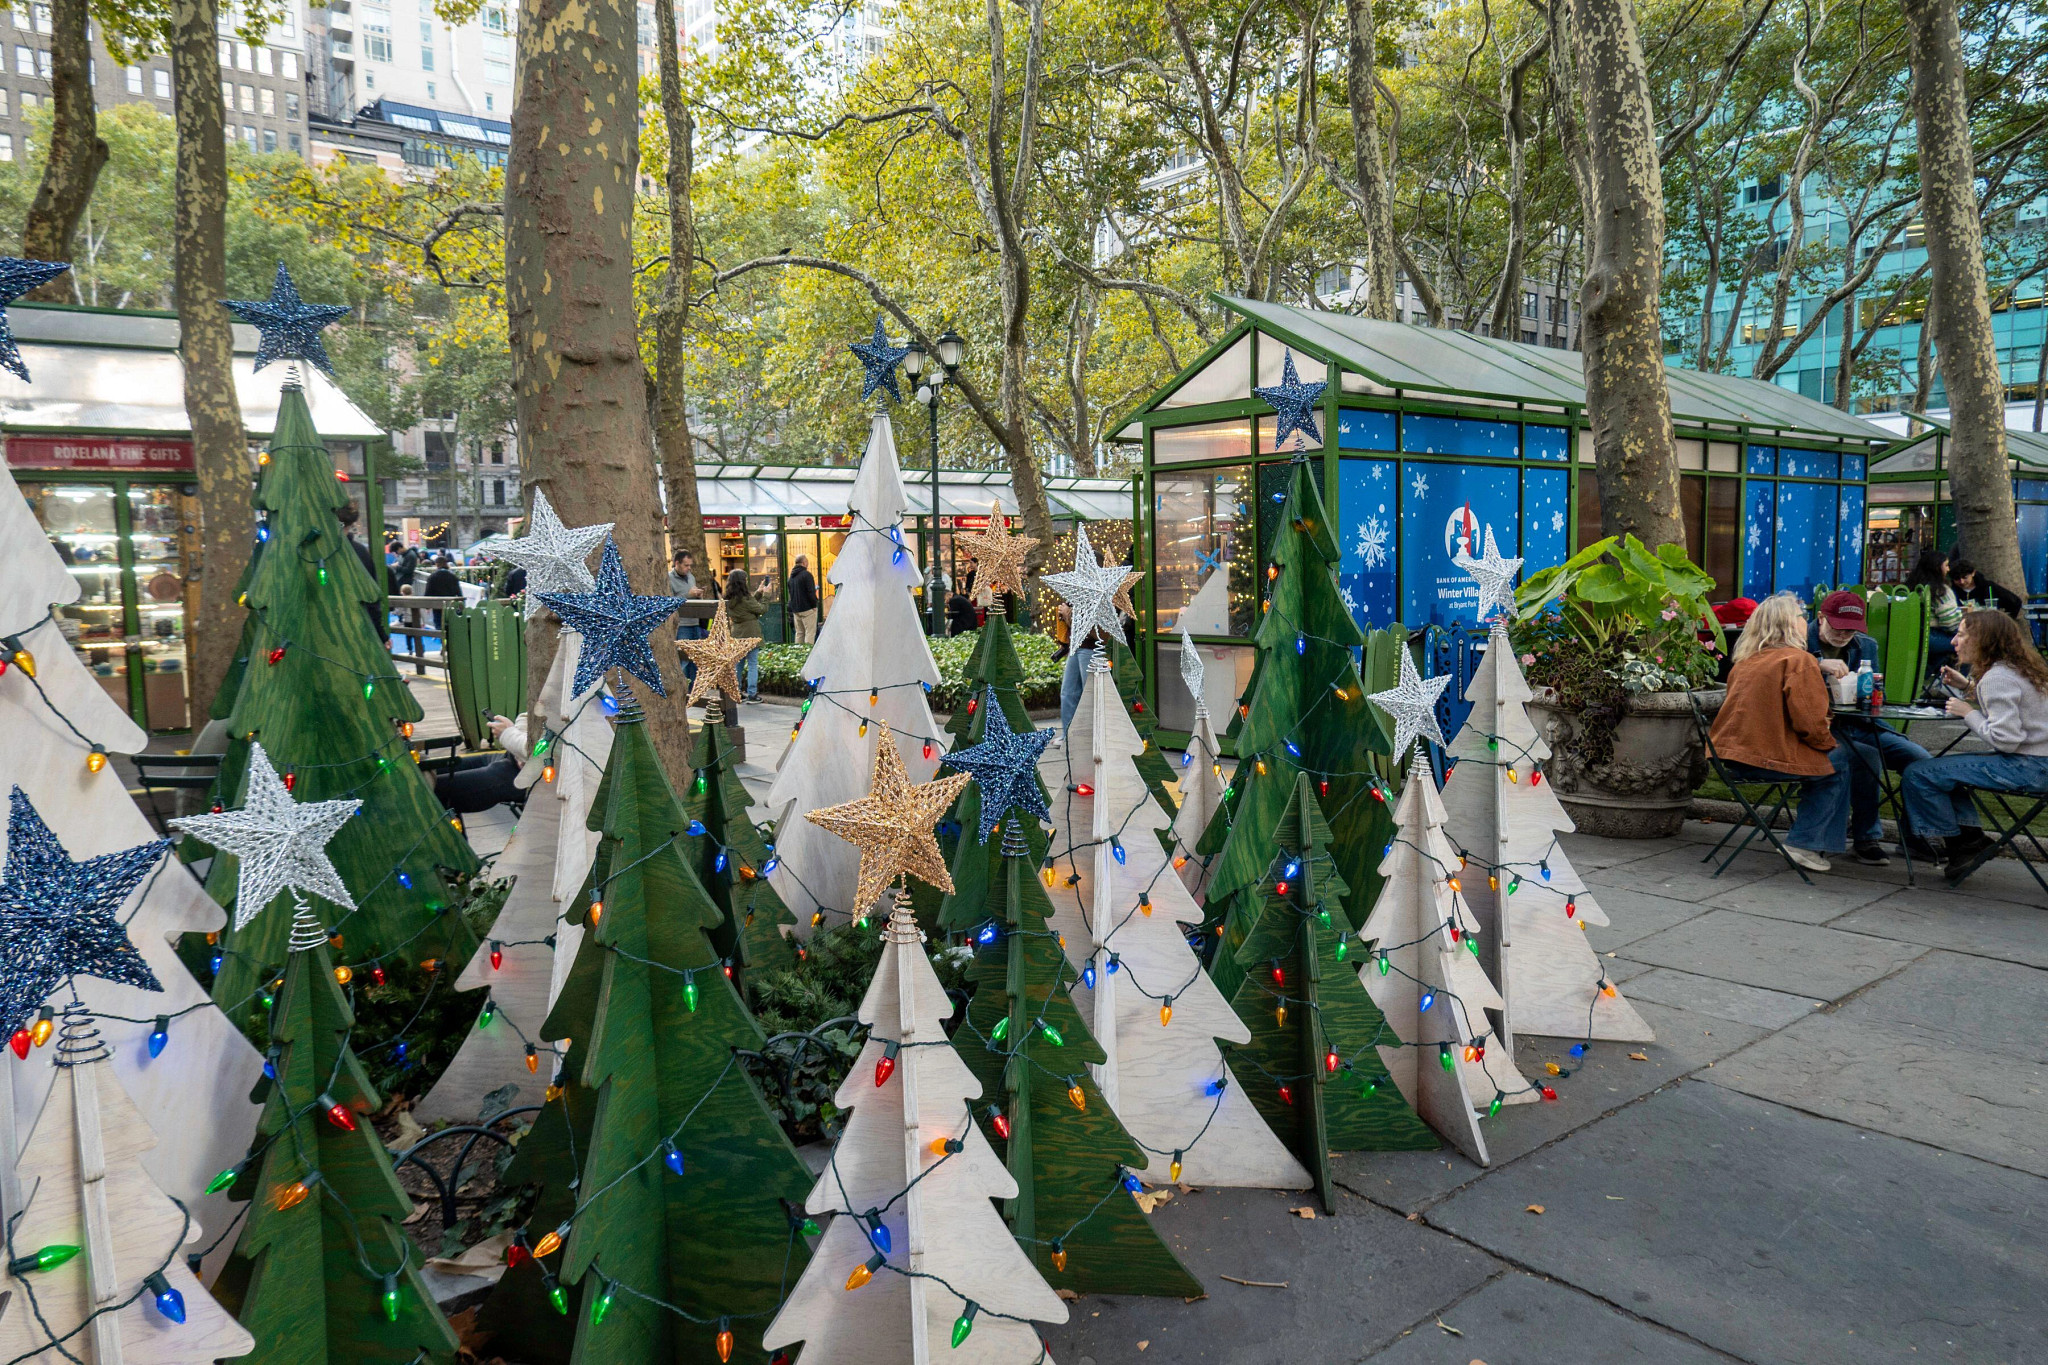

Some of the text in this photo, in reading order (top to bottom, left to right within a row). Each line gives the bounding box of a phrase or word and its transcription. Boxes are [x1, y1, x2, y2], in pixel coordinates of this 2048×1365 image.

[53, 446, 182, 461] ROXELANA FINE GIFTS
[1437, 586, 1479, 599] Winter Villa
